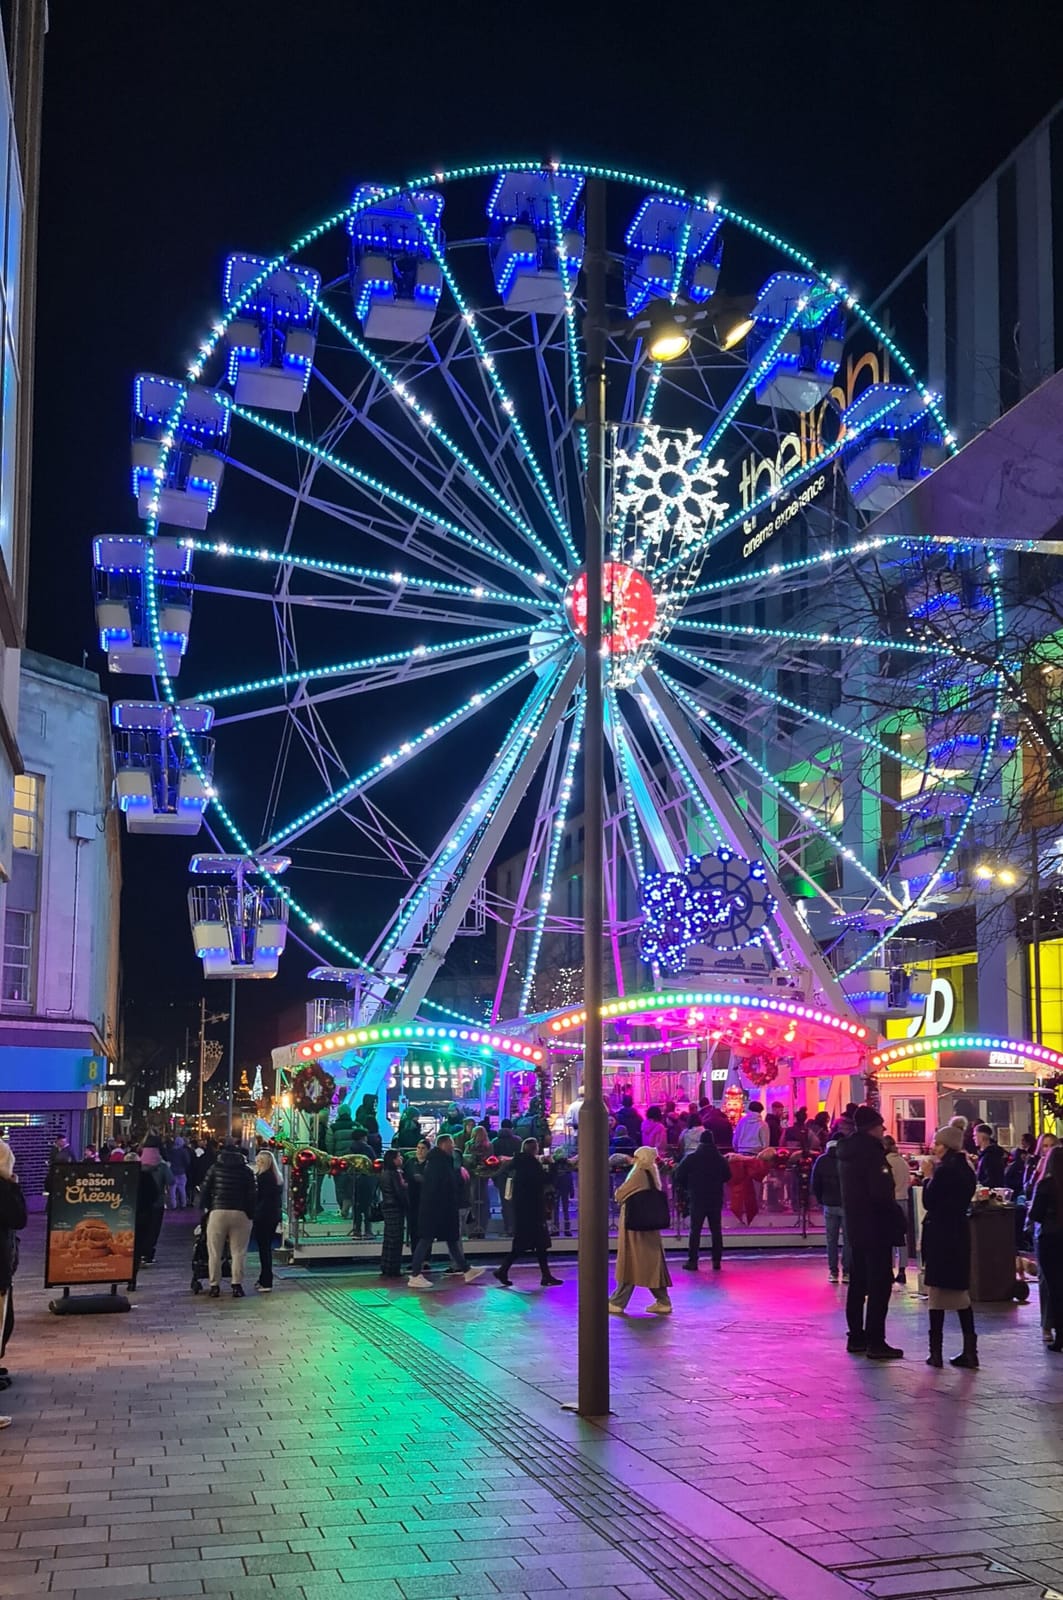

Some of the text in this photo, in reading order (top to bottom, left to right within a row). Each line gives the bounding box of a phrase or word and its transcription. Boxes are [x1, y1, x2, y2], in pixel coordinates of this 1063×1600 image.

[743, 475, 825, 558] cinema experience
[76, 1178, 115, 1186] season
[65, 1185, 123, 1209] Cheesy
